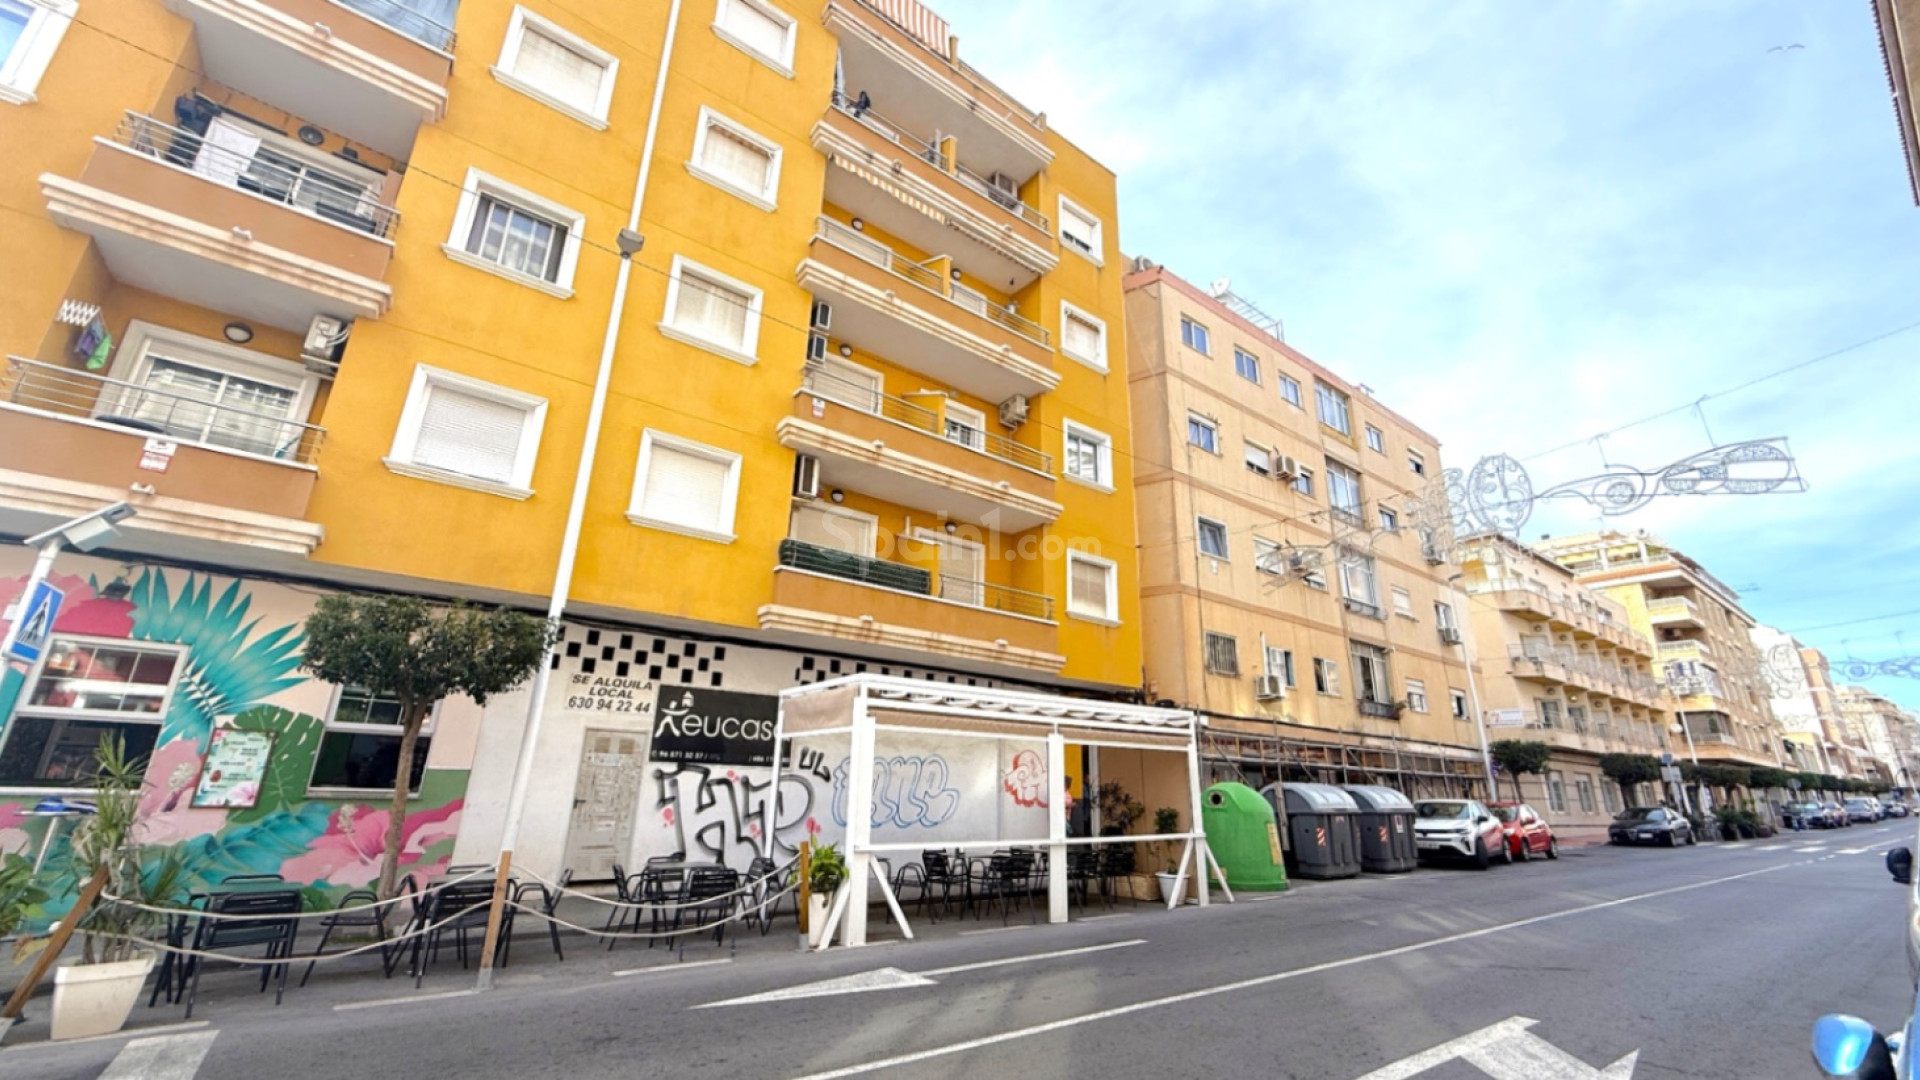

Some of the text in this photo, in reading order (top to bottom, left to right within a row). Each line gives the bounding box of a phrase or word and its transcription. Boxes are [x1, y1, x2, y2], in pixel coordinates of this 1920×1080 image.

[572, 673, 653, 691] SE ALQUILA
[589, 687, 634, 699] LOCAL
[568, 695, 651, 713] 630 94 22 44
